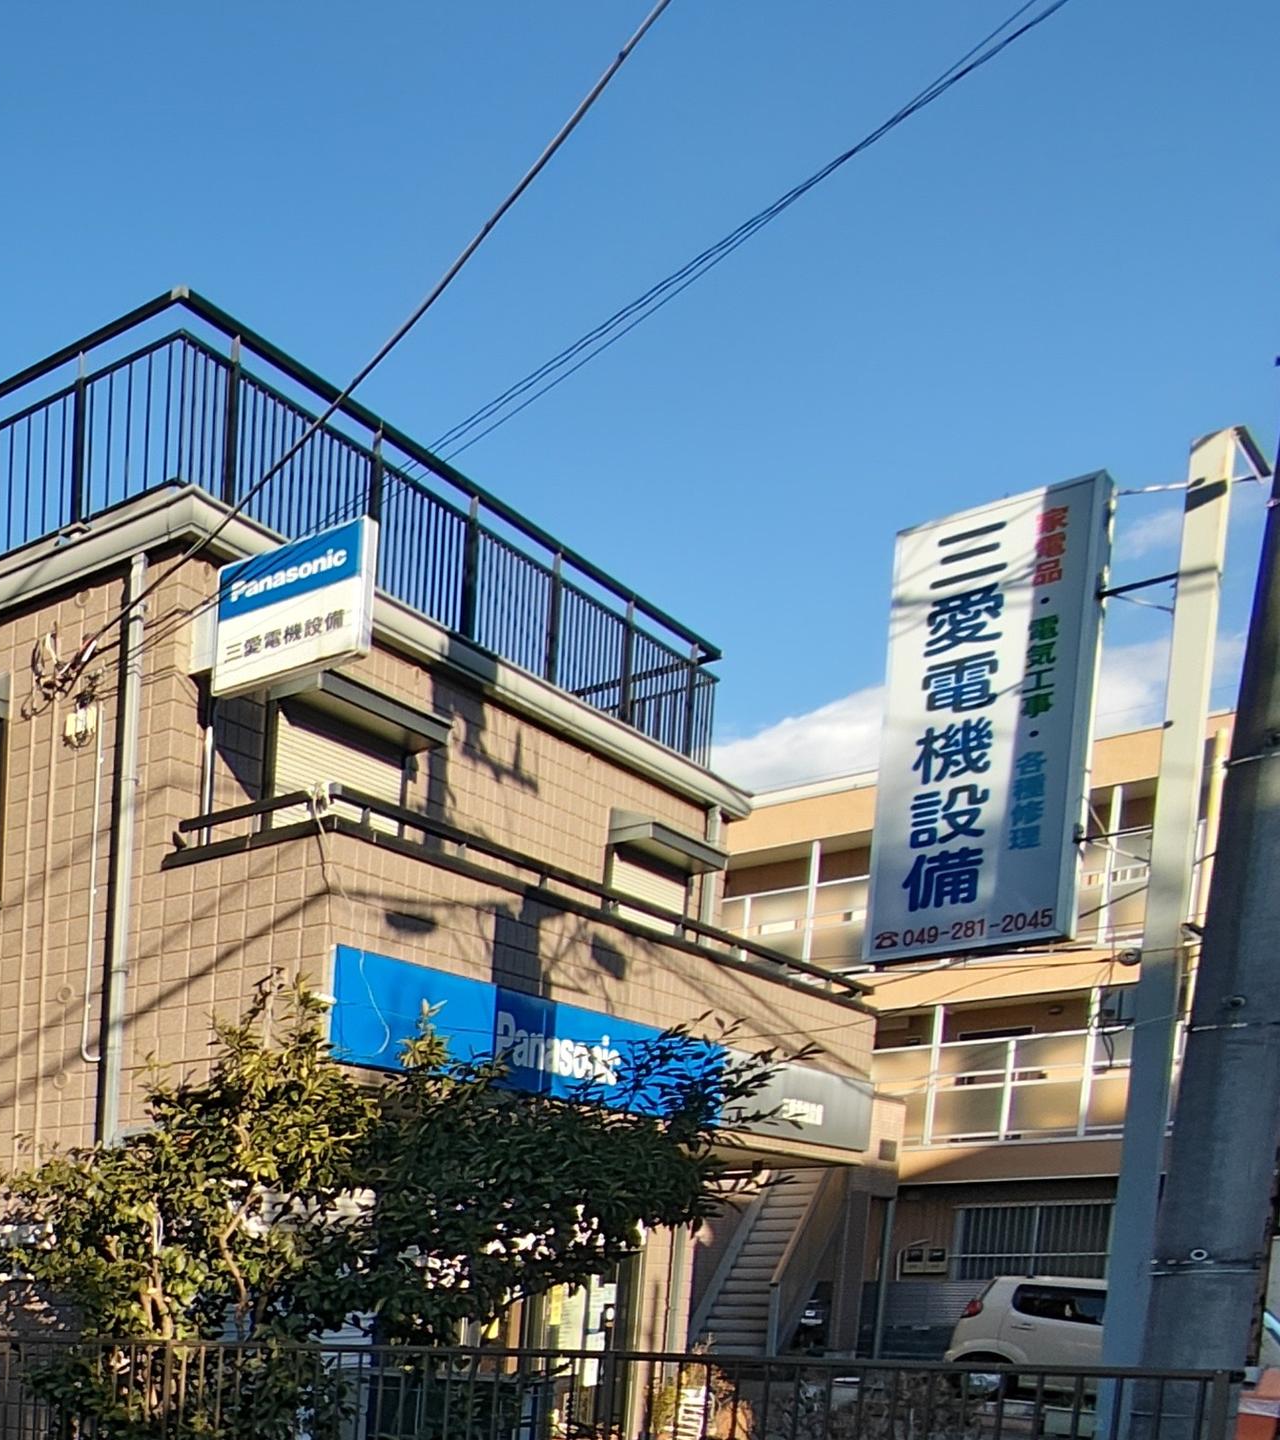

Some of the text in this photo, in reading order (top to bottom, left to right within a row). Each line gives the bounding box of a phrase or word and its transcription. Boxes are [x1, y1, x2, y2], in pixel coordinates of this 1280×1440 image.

[229, 548, 348, 603] Panasonic
[224, 608, 345, 664] 三愛電機設備
[901, 520, 1008, 913] 三愛電機設備
[902, 907, 1054, 948] 049-281-2045
